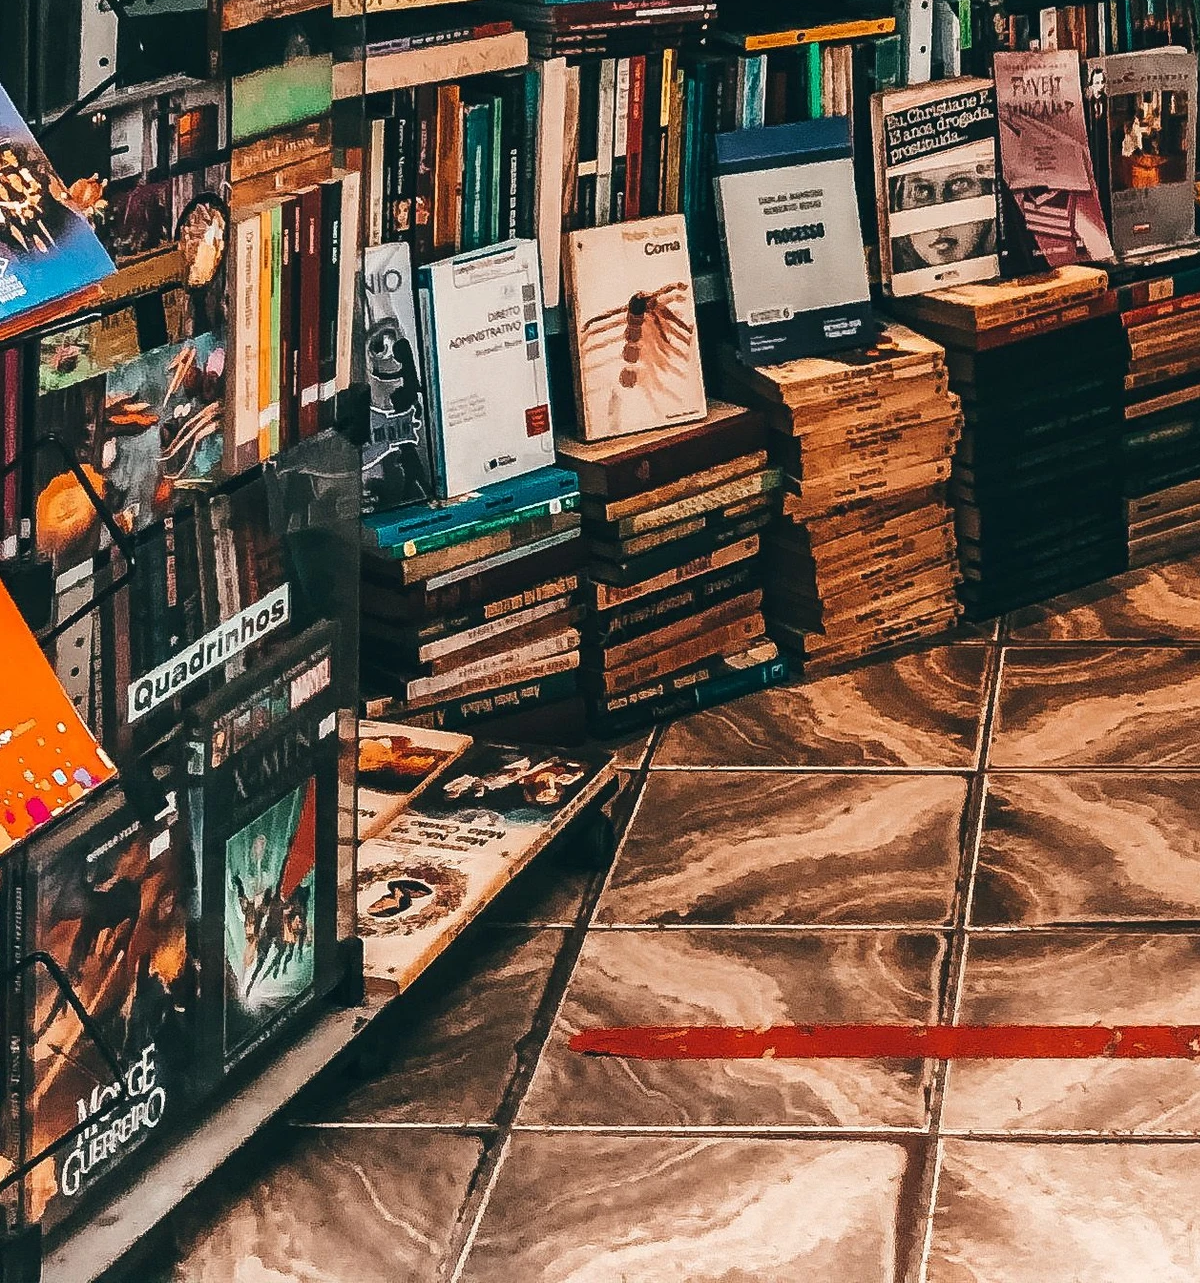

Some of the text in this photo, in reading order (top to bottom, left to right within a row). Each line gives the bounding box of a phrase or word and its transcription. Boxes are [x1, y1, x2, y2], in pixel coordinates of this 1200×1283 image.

[907, 98, 977, 125] Christiane
[979, 90, 993, 106] F.
[765, 221, 826, 246] PROCESSO
[644, 239, 681, 256] Coma
[783, 247, 815, 268] CIVIL
[487, 305, 520, 322] DIREITO
[782, 307, 790, 319] 6
[449, 320, 522, 350] ADMINISTRATIVO
[133, 598, 285, 713] Quadrinhos
